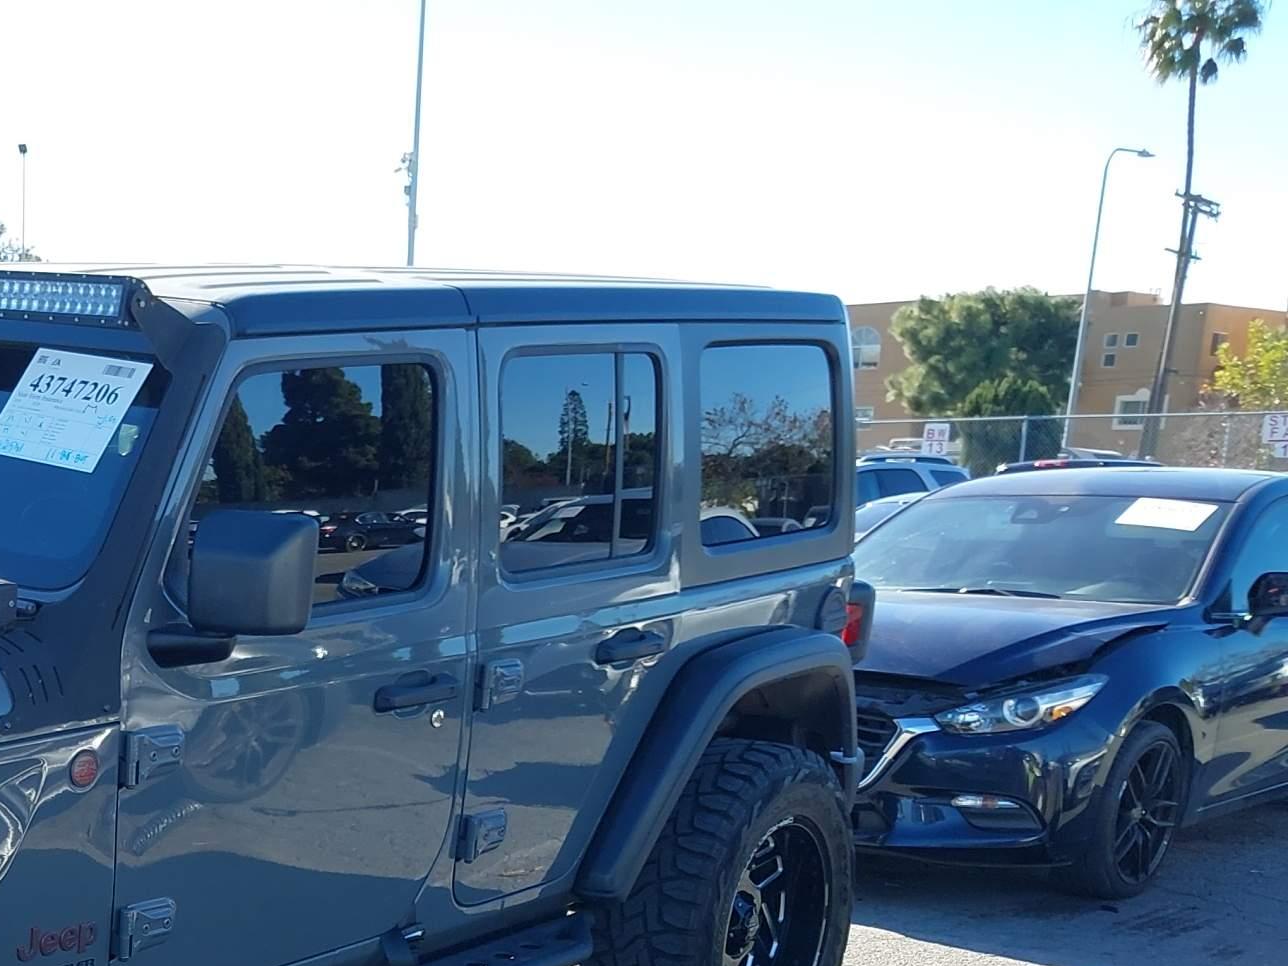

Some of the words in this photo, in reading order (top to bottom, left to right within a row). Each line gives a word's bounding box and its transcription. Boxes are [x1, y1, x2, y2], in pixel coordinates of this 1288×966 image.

[29, 373, 125, 406] 43747206
[927, 442, 944, 454] 13
[16, 920, 97, 963] Jeep
